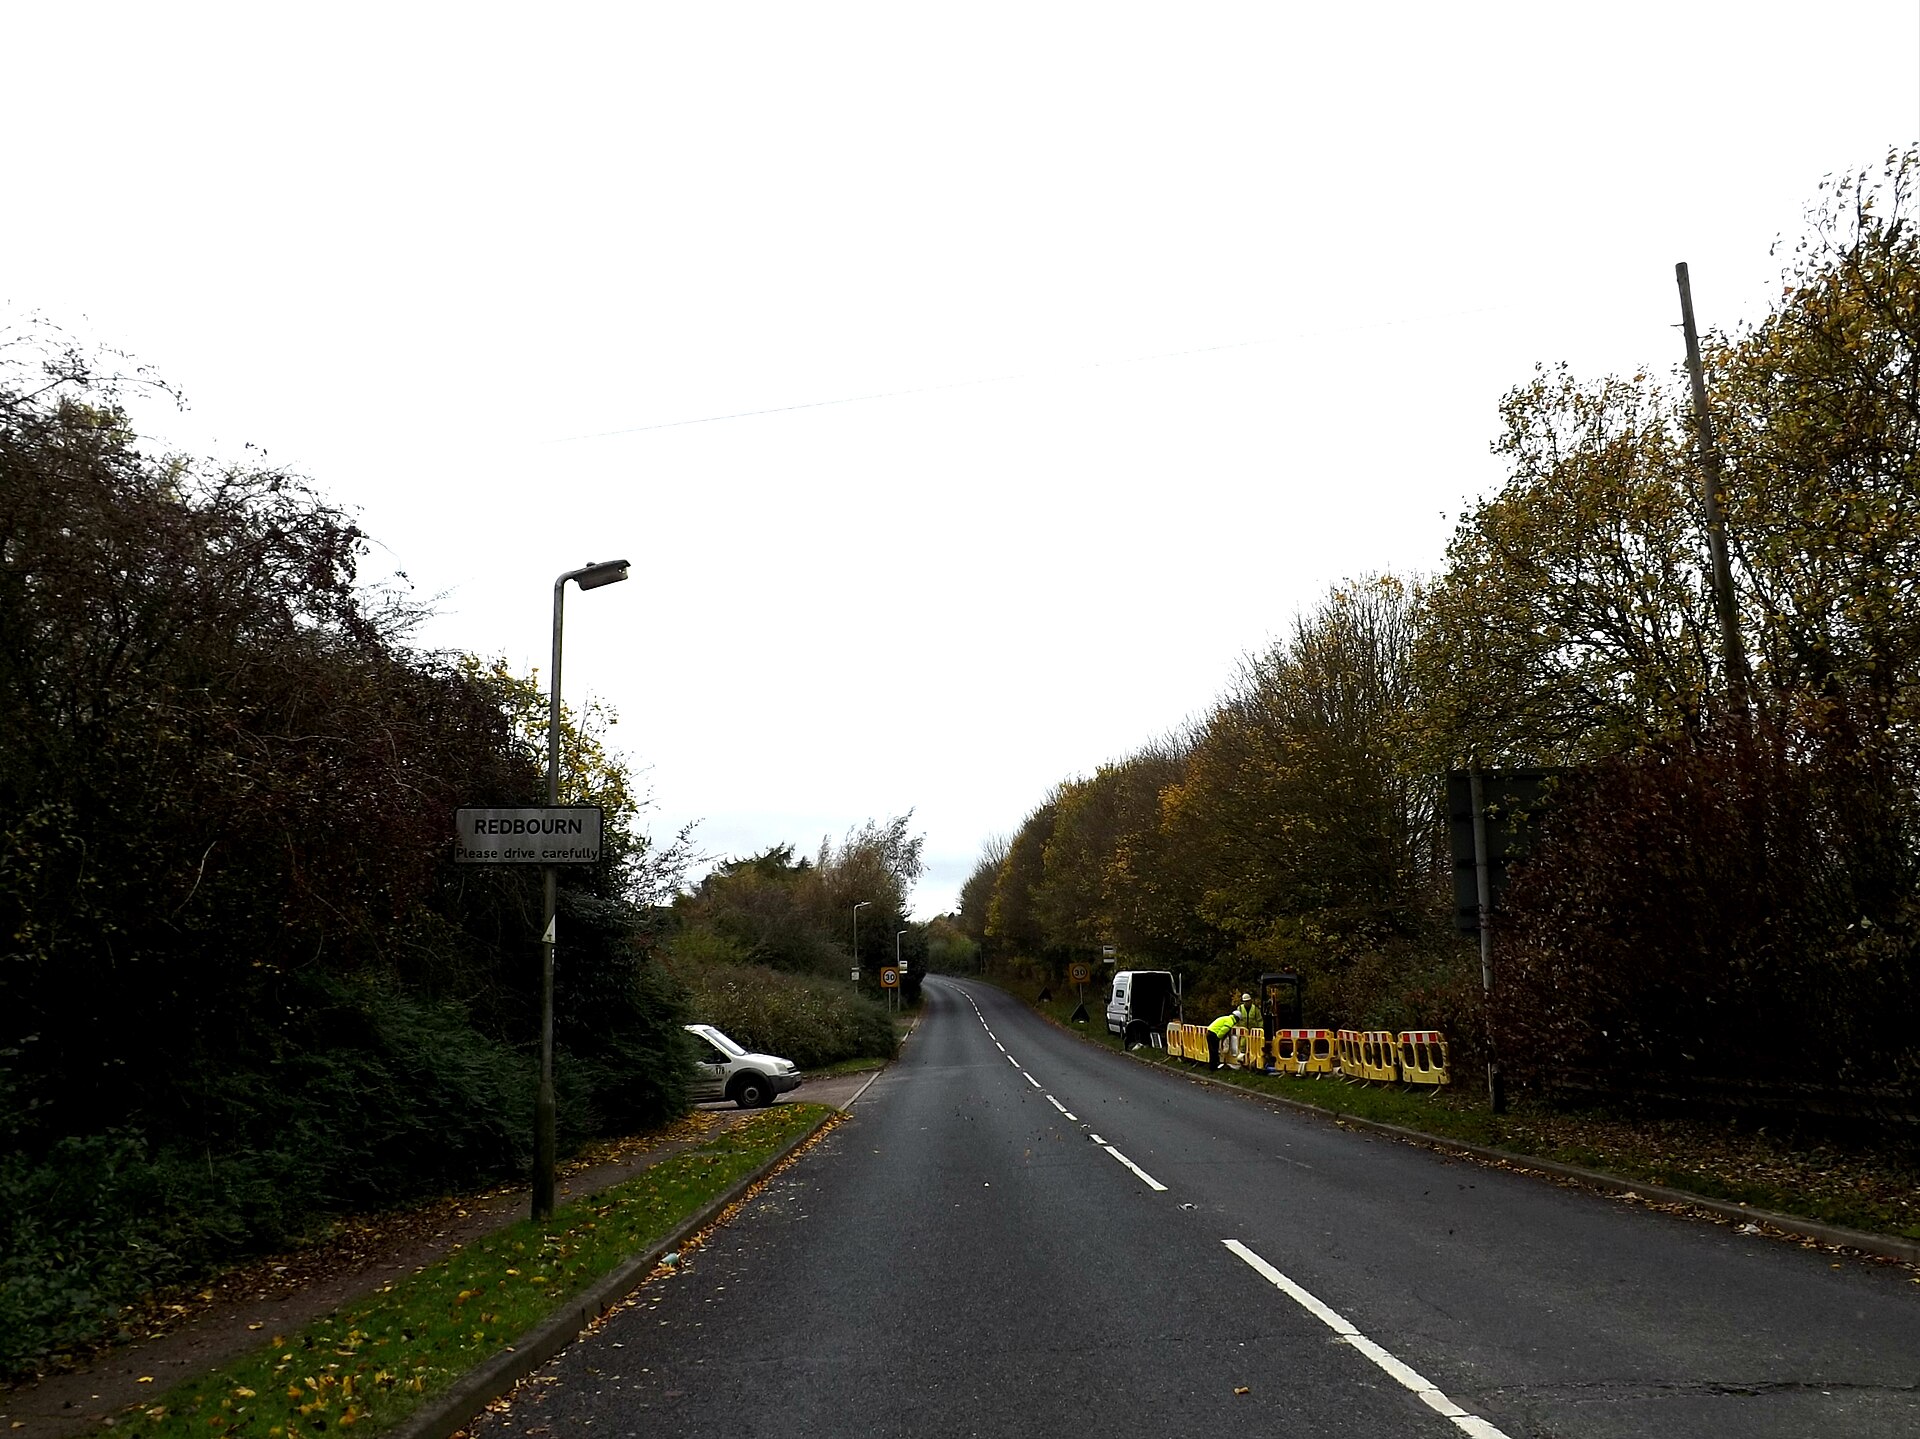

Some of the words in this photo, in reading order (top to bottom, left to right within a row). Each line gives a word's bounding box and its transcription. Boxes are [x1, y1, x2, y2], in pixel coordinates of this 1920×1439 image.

[475, 819, 582, 834] REDBOURN
[456, 848, 497, 858] Please
[504, 848, 535, 858] drive
[542, 848, 598, 860] carefully
